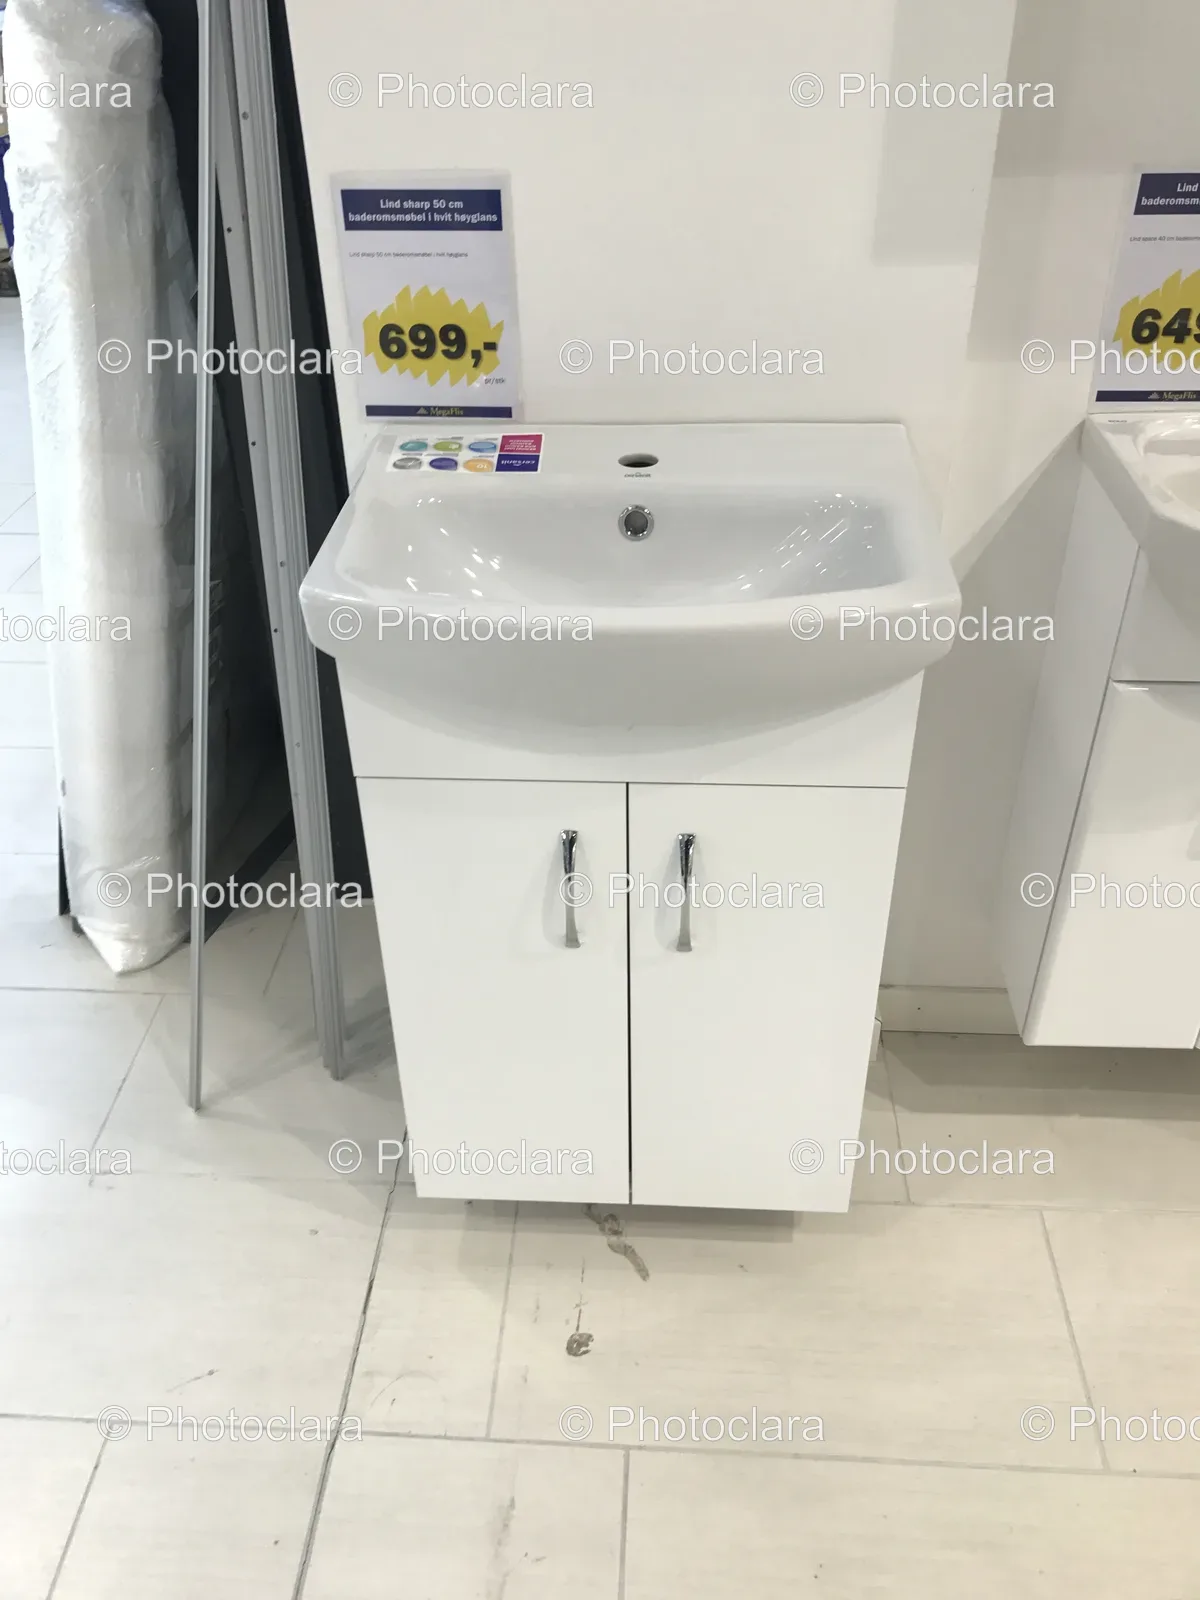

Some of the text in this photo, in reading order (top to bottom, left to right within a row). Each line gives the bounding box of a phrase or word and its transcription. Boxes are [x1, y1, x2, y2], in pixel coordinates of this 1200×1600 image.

[1176, 182, 1199, 192] Lind
[380, 199, 464, 211] Lind sharp 50 cm
[1140, 196, 1200, 206] baderomsm
[348, 212, 498, 224] baderomsmøbel i hvit høyglans
[1131, 307, 1200, 344] 64
